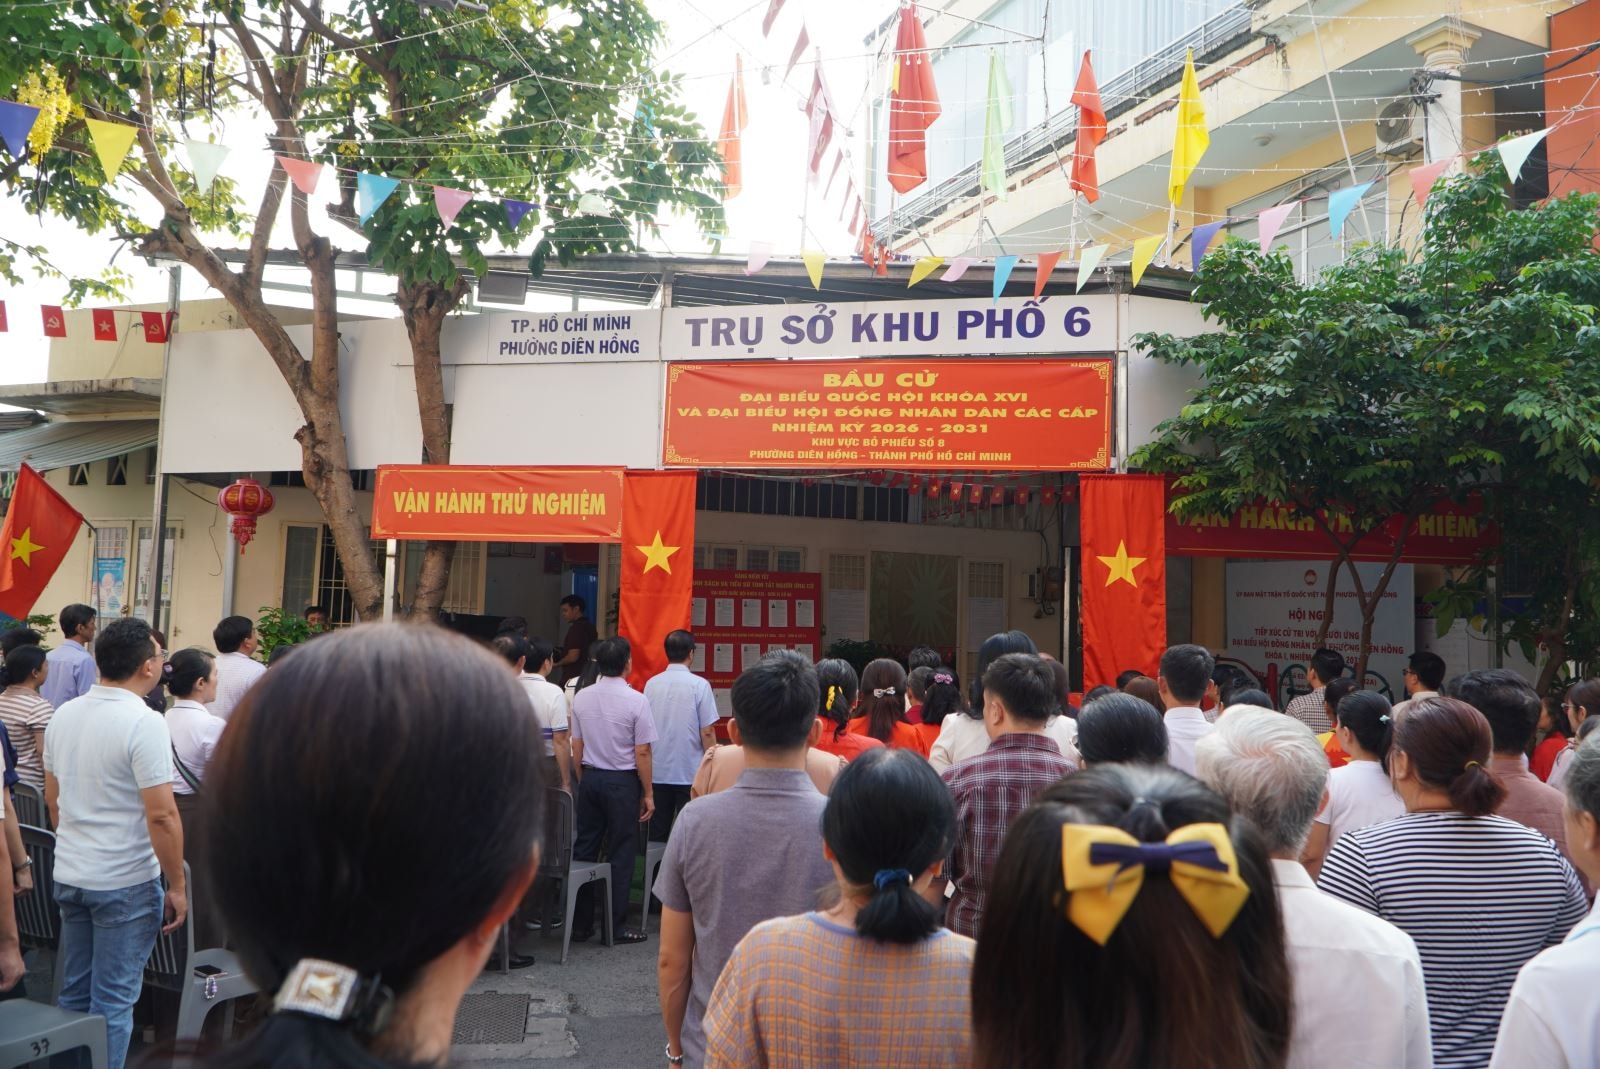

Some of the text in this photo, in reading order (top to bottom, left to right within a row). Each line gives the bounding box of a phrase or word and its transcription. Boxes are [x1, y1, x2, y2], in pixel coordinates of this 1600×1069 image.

[538, 313, 559, 333] HỒ
[563, 313, 587, 332] CHÍ
[684, 296, 1091, 353] TRỤ SỞ KHU PHỐ 6
[499, 336, 557, 355] PHƯỜNG
[599, 333, 640, 354] HỒNG
[823, 369, 939, 388] BẦU CỬ
[739, 390, 1028, 404] ĐẠI BIỂU QUỐC HỘI KHÓA XVI
[677, 405, 1099, 419] VÀ ĐẠI BIỂU HỘI ĐỒNG NHÂN DÂN CÁC CẤP
[771, 422, 834, 434] NHIỆM
[840, 421, 865, 433] KỲ
[870, 423, 919, 433] 2026
[940, 423, 988, 433] 2031
[811, 436, 945, 447] KHU VỰC BỎ PHIẾU SỐ 8
[749, 448, 795, 459] PHƯỜNG
[797, 448, 824, 459] DIÊN
[826, 448, 858, 460] HỒNG
[868, 449, 907, 460] THÀNH
[910, 449, 934, 460] PHỐ
[936, 448, 952, 460] HỒ
[956, 450, 976, 461] CHÍ
[979, 451, 1012, 461] MINH
[393, 486, 606, 520] VẬN HÀNH THỬ NGHIỆM
[1288, 608, 1306, 622] HỘI
